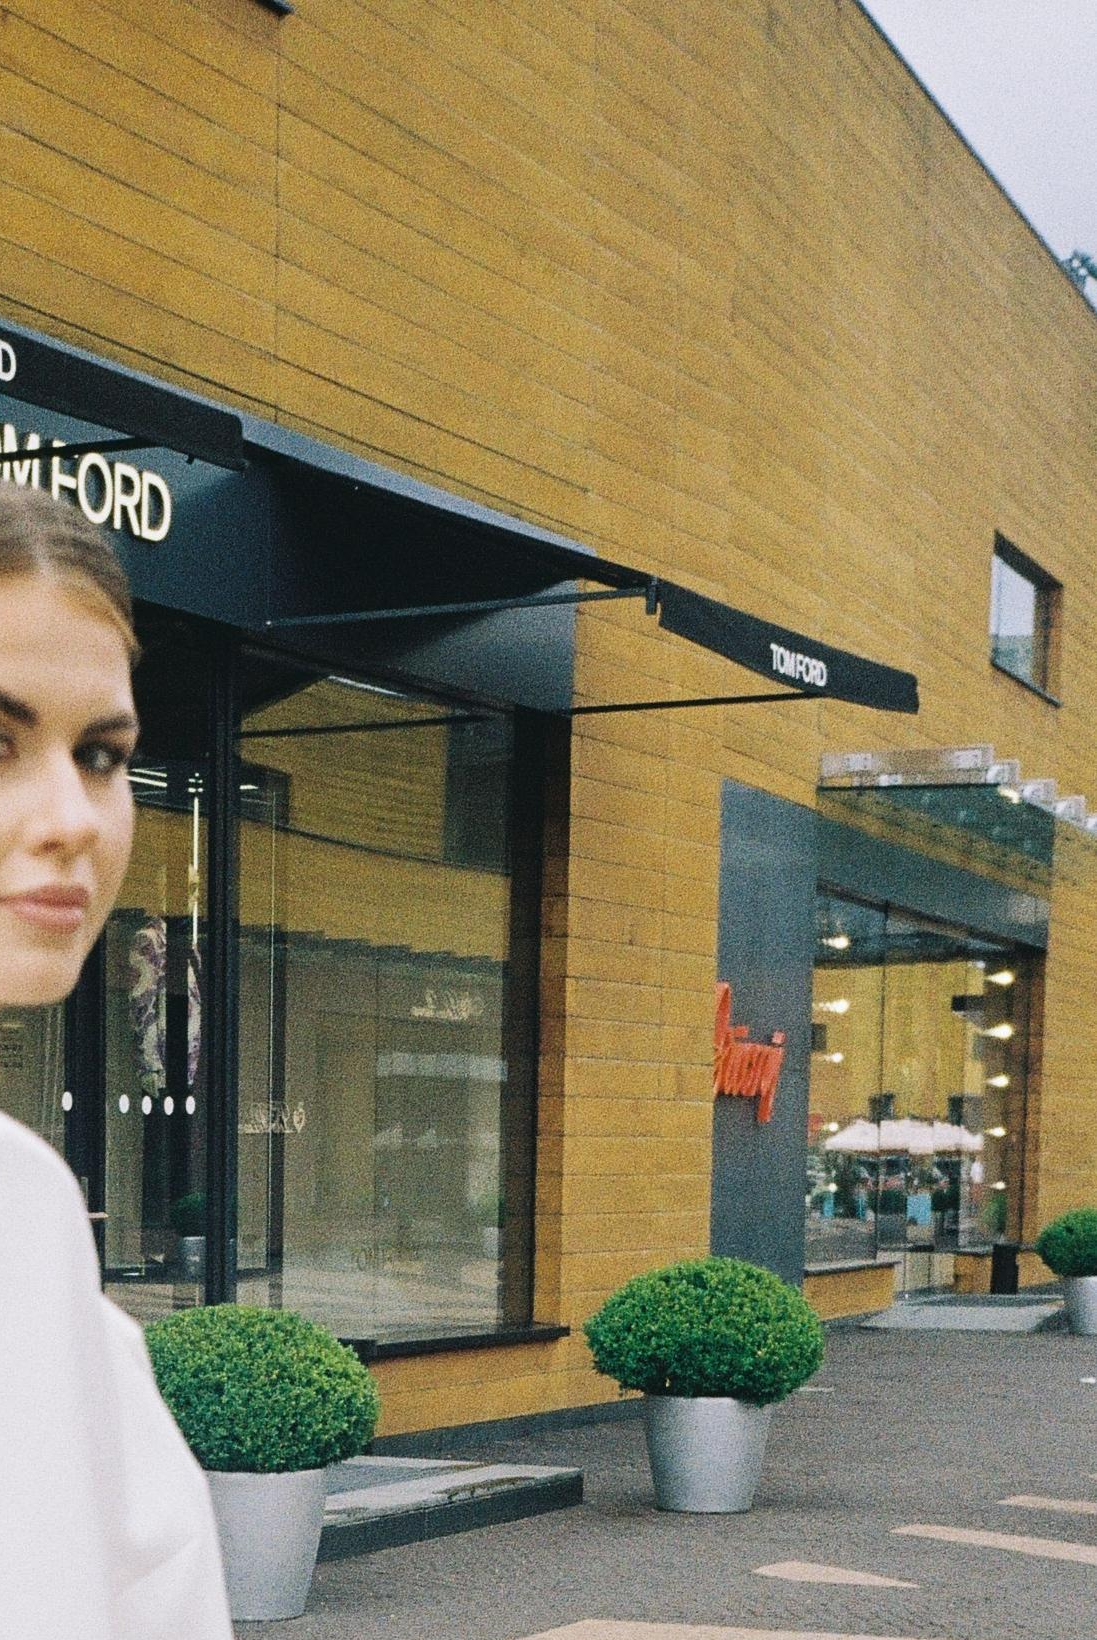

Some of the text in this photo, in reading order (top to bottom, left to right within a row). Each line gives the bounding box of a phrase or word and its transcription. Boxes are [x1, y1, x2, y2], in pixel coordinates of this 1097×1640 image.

[52, 440, 172, 542] FORD
[770, 643, 827, 687] TOM FORD
